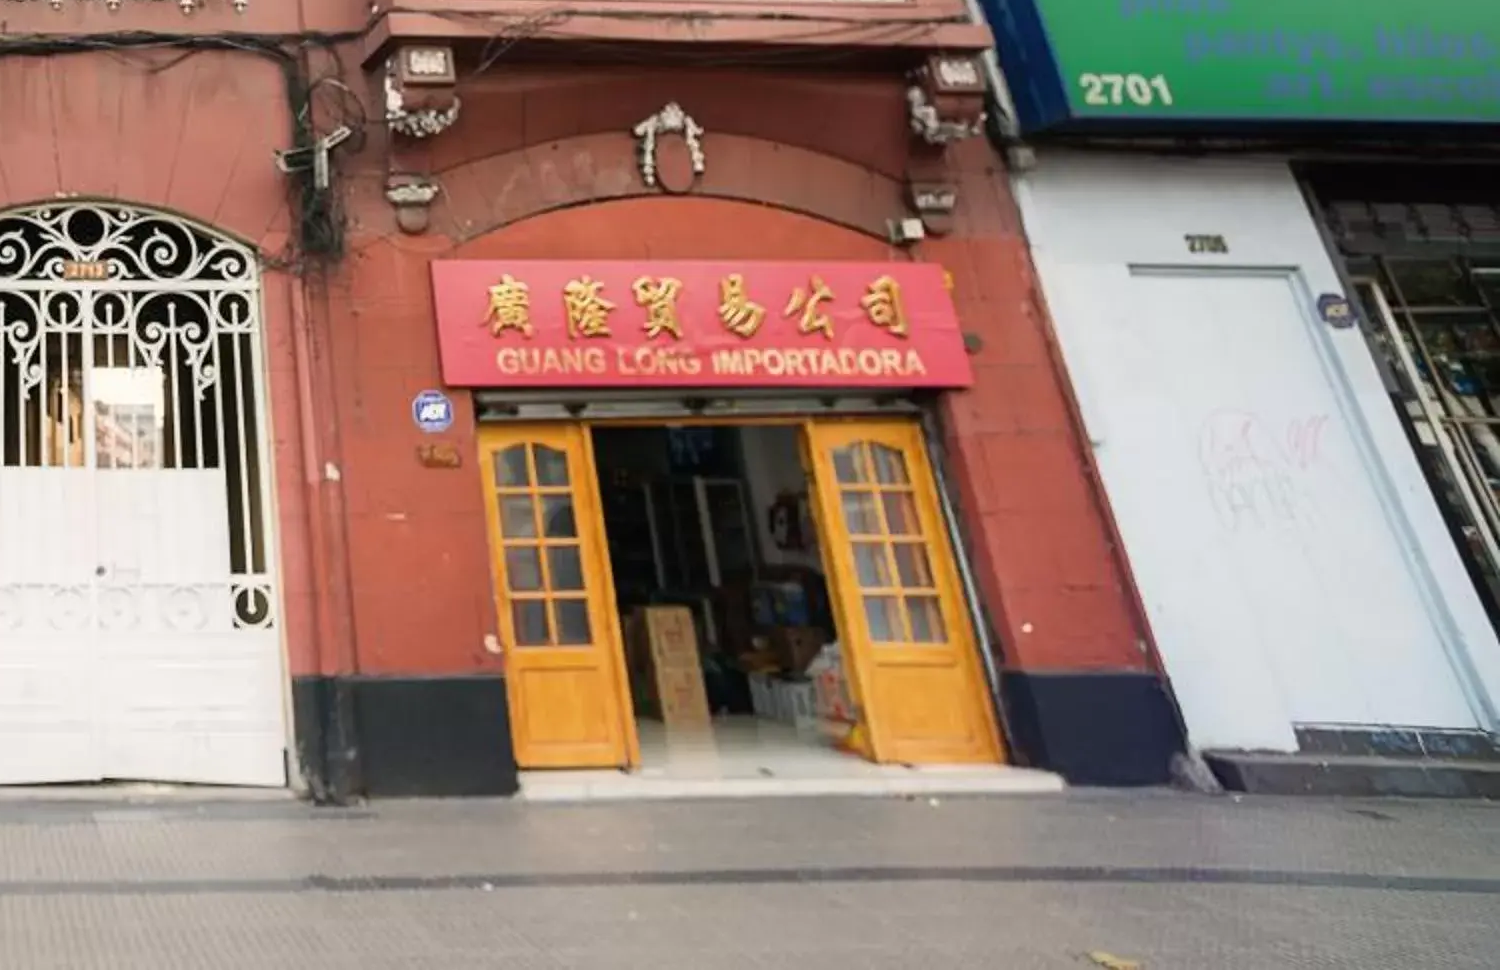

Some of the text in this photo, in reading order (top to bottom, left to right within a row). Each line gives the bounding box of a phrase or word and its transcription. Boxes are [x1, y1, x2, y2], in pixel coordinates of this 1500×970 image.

[1079, 73, 1174, 106] 2701
[485, 273, 909, 339] 廣隆貿易公司
[497, 347, 926, 376] GUANG LONG IMPORTADORA
